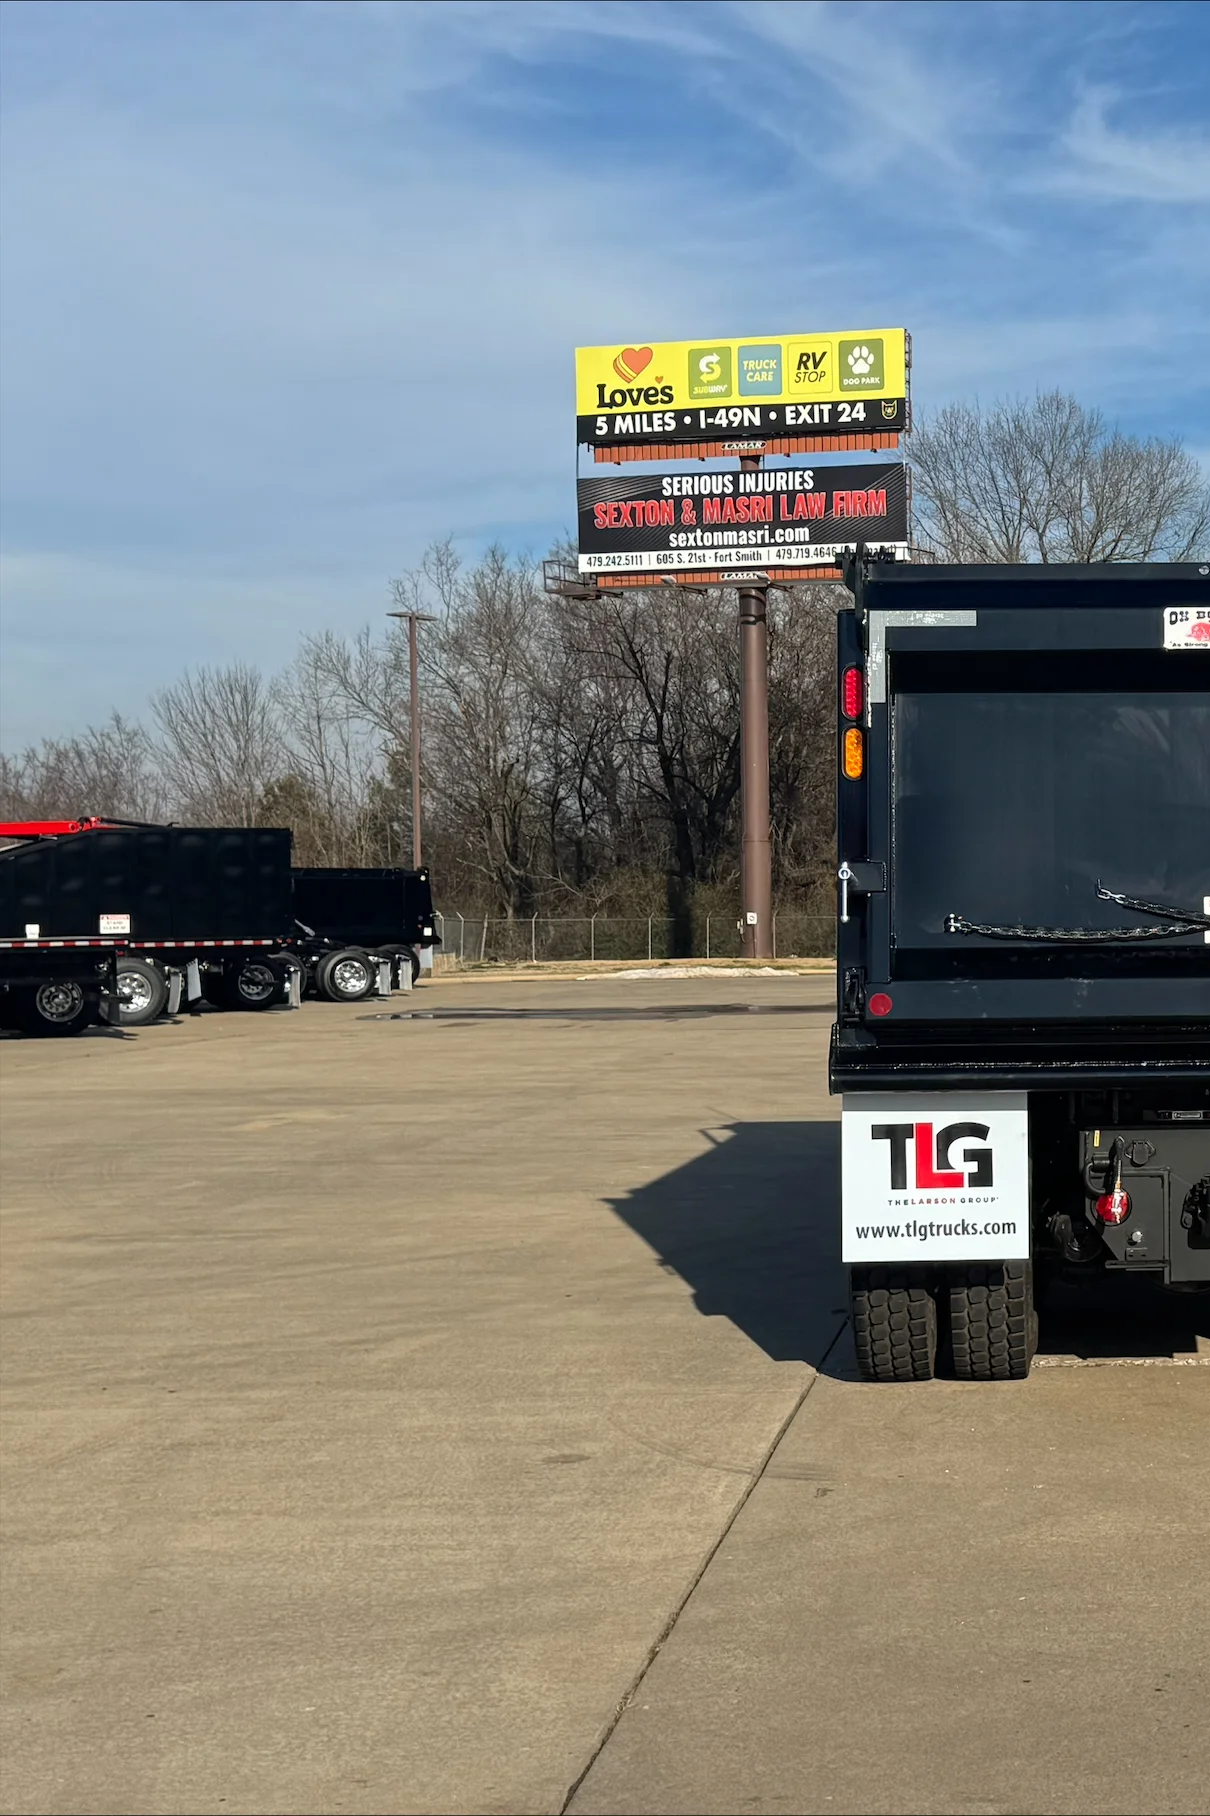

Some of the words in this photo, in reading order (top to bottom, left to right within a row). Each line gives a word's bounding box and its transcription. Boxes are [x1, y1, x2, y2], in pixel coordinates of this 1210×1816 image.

[743, 359, 777, 371] TRUCK
[796, 351, 827, 371] RV
[746, 371, 774, 382] CARE
[794, 371, 826, 384] STOP
[861, 376, 880, 384] PARK
[692, 384, 728, 395] SUBWAY
[595, 416, 609, 436] 5
[614, 412, 677, 435] MILES
[700, 406, 761, 430] I-49N
[785, 404, 832, 426] EXIT
[837, 402, 867, 423] 24
[723, 441, 762, 450] LAMAR
[662, 474, 734, 496] SERIOUS
[739, 470, 814, 493] INJURIES
[593, 500, 675, 529] SEXTON
[681, 498, 697, 526] &
[702, 494, 774, 525] MASRI
[780, 492, 827, 521] LAW
[832, 489, 887, 517] FIRM
[669, 525, 810, 547] sextonmasri.com
[586, 554, 643, 567] 479.242.5111
[656, 553, 674, 565] 605
[677, 553, 686, 564] S.
[688, 552, 706, 564] 21st
[714, 551, 732, 563] Fort
[735, 550, 762, 562] Smith
[775, 546, 837, 560] 479.719.4646
[723, 572, 758, 580] LAMA
[1169, 611, 1189, 625] OX
[871, 1121, 994, 1190] TLG
[960, 1196, 996, 1204] GROUP
[856, 1219, 1017, 1241] www.tlgtrucks.com
